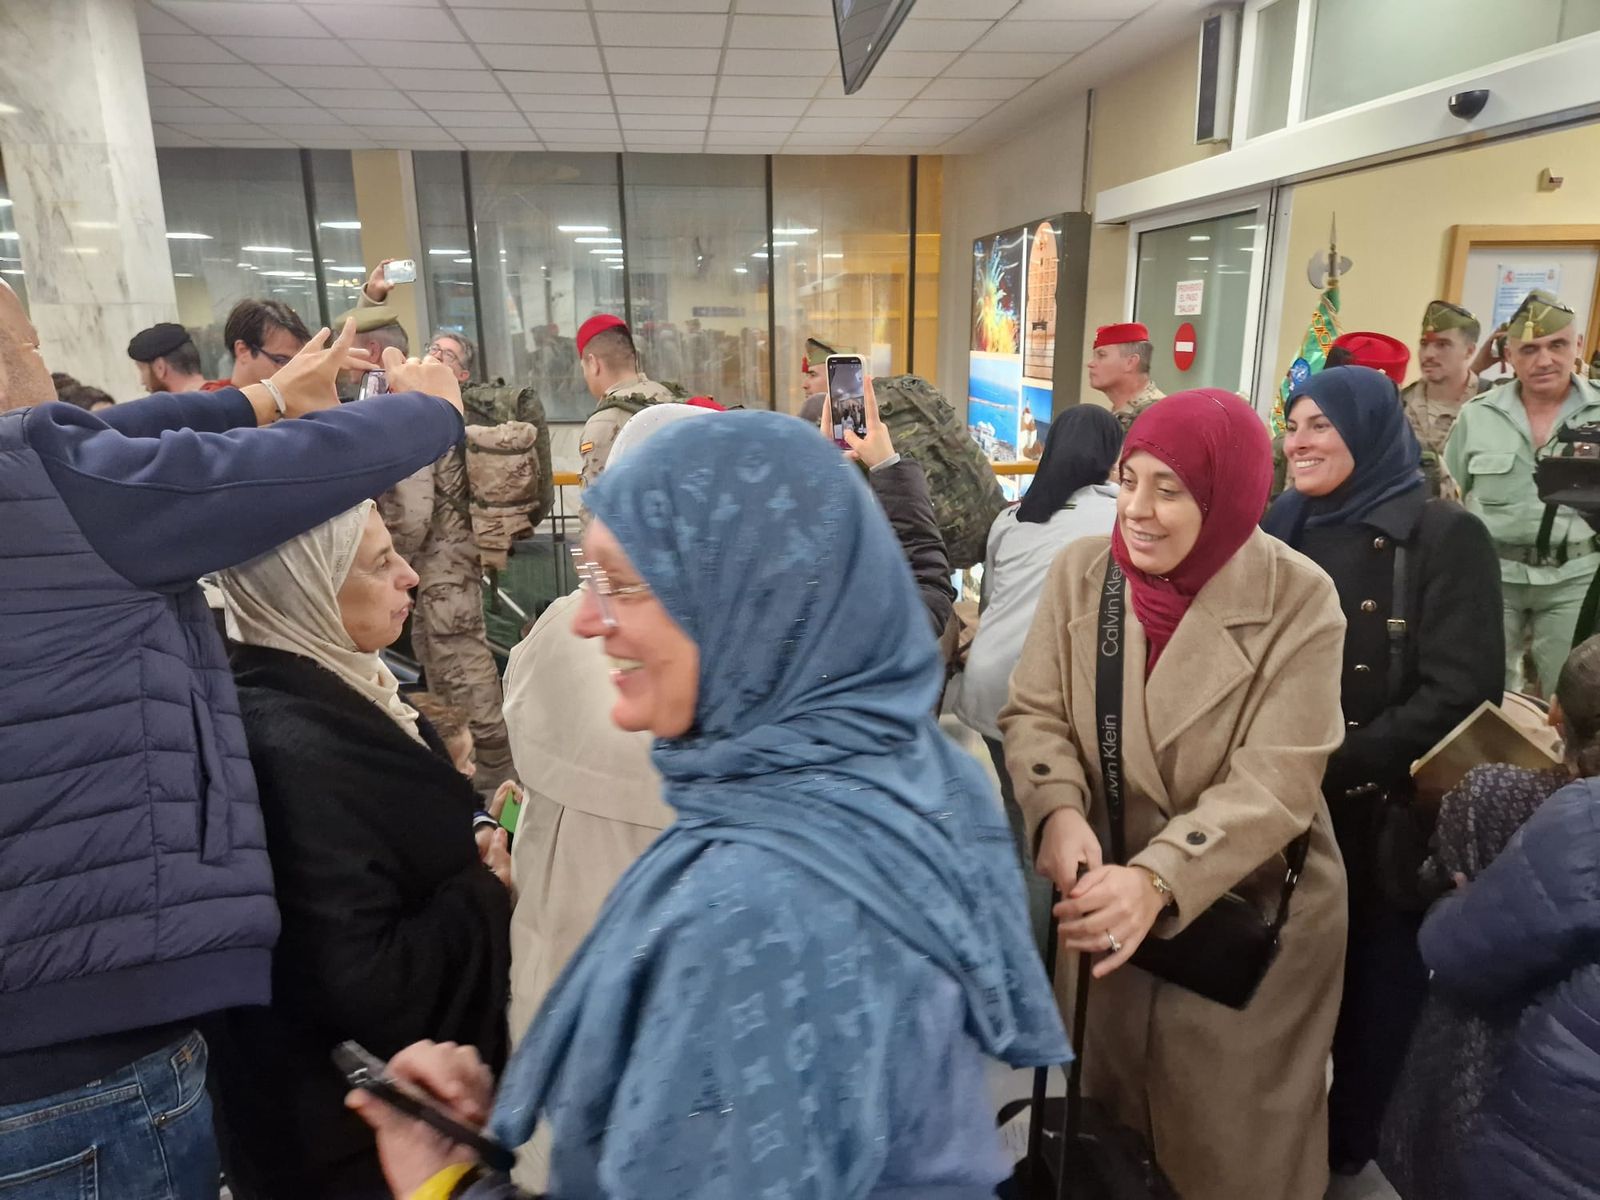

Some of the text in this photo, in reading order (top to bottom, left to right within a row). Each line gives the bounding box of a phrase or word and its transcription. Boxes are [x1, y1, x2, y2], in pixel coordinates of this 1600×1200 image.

[1101, 562, 1122, 656] Calvin Klei
[1102, 713, 1119, 820] alvin Klein
